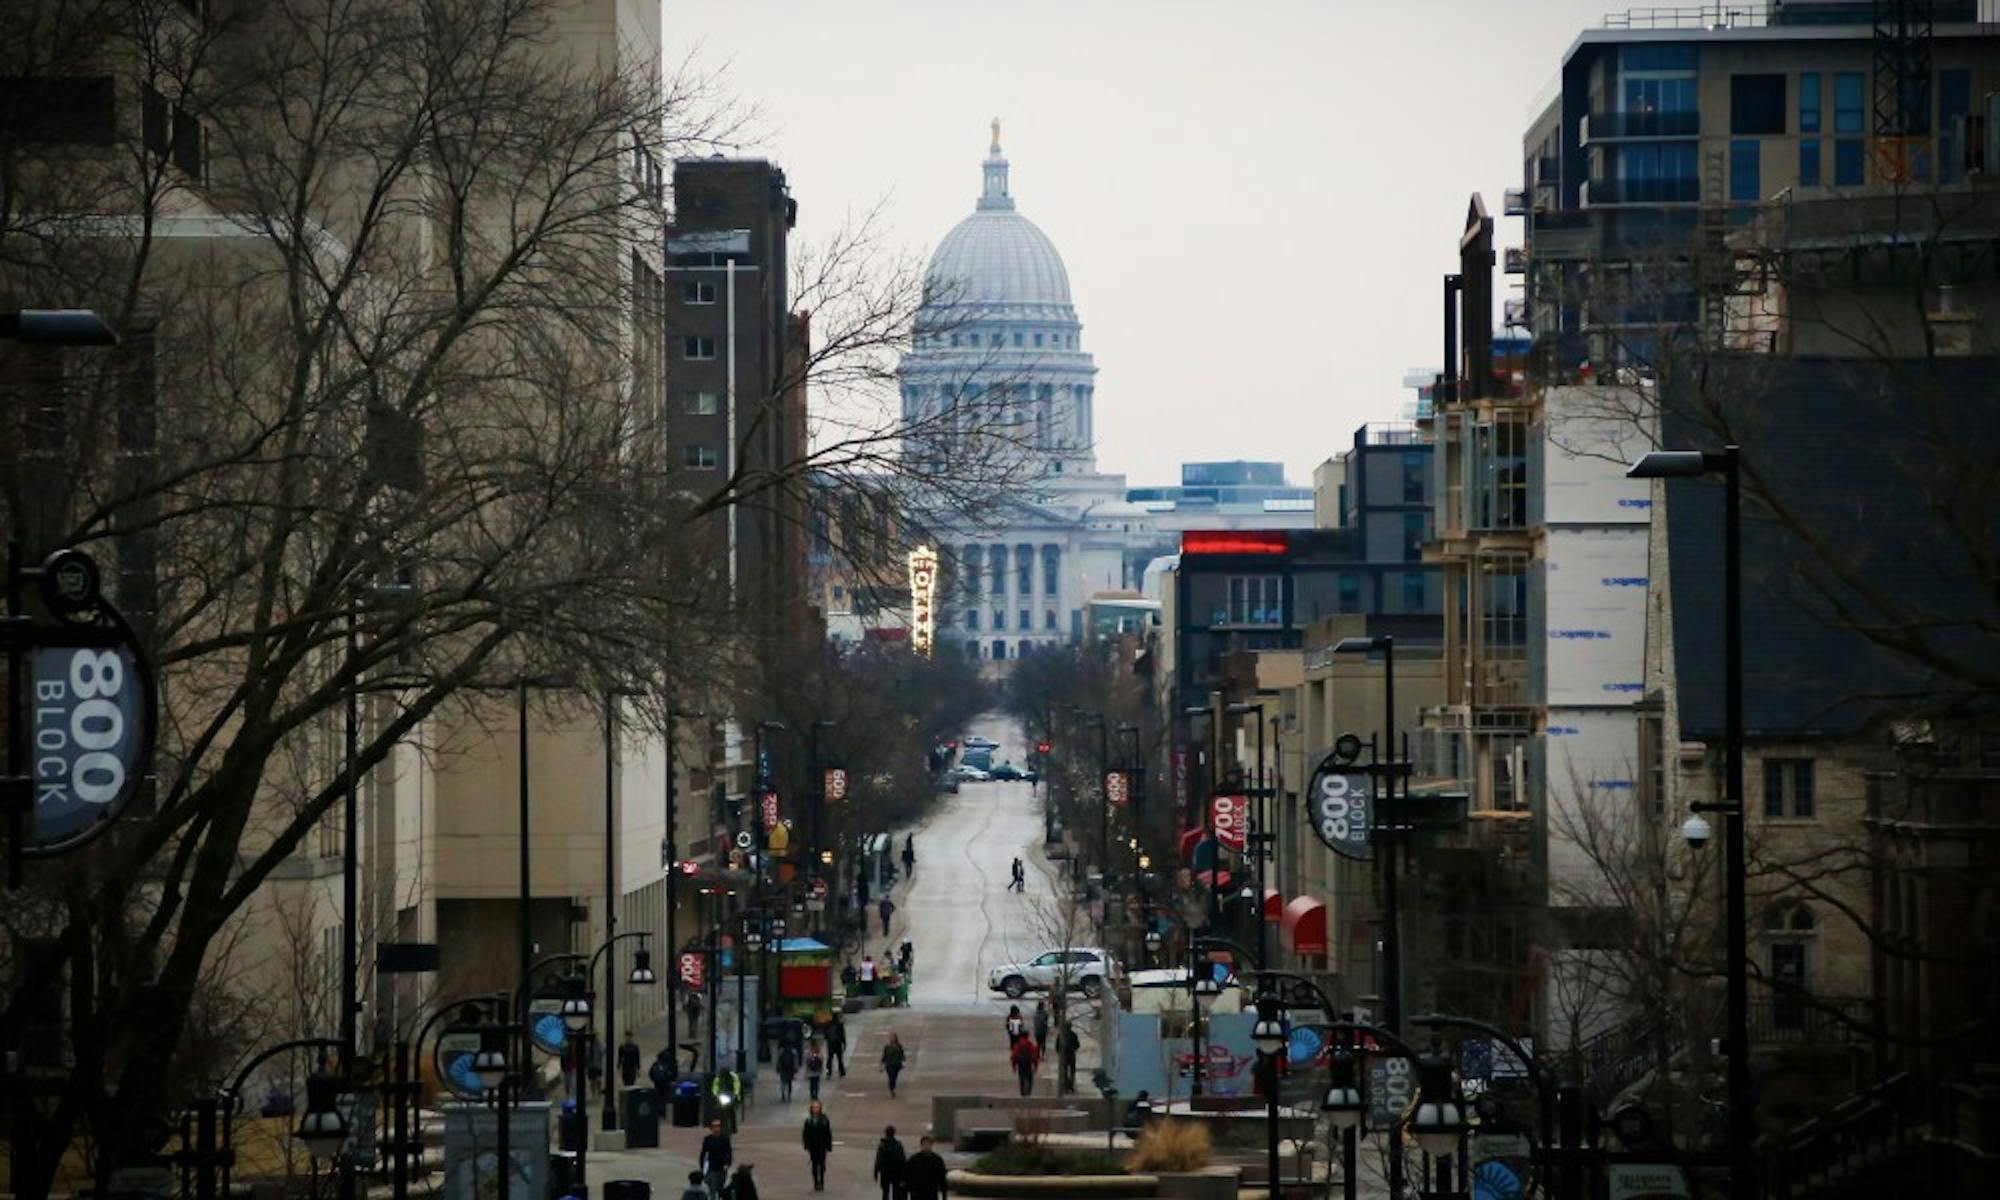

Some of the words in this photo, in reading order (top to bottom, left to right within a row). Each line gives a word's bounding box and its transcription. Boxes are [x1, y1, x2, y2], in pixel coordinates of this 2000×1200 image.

[37, 680, 68, 804] BLOCK
[70, 648, 125, 804] 800
[832, 768, 846, 800] 600
[1321, 773, 1349, 841] 800
[1215, 797, 1233, 840] 700
[1349, 788, 1366, 842] BLOCK
[680, 953, 695, 983] 700
[1385, 1056, 1410, 1115] 800
